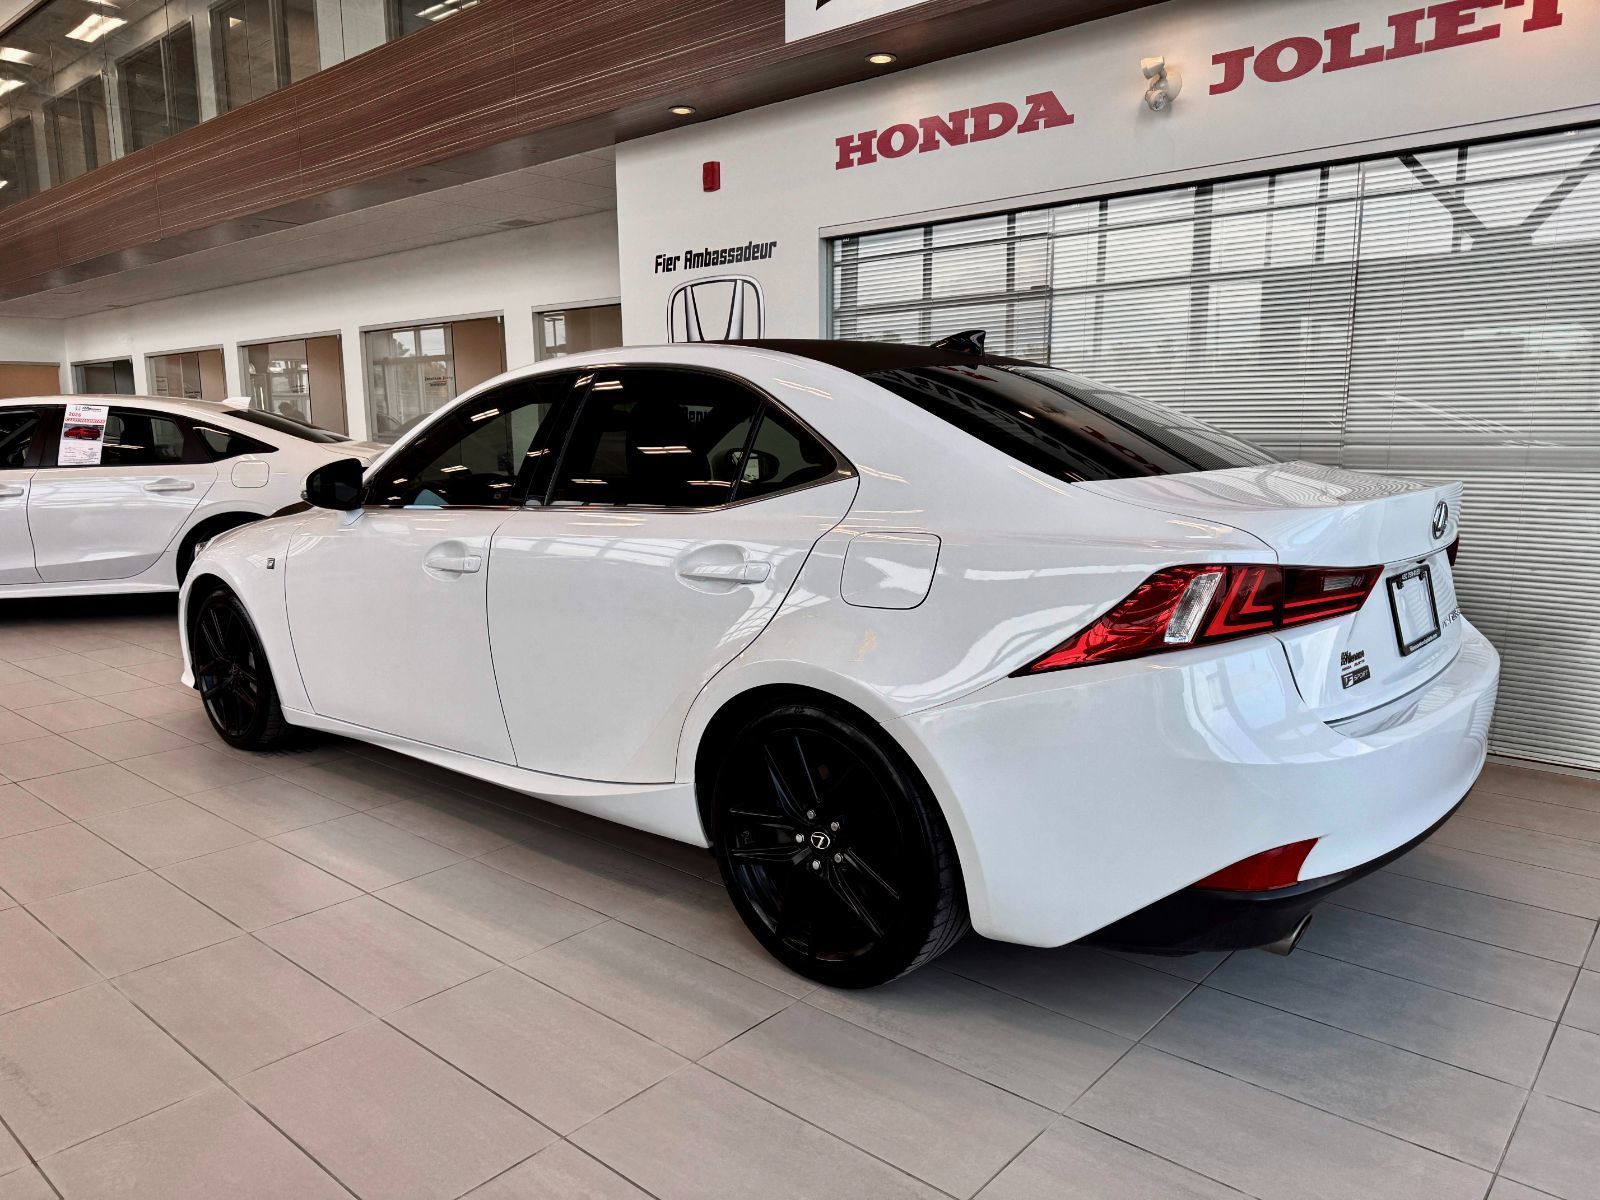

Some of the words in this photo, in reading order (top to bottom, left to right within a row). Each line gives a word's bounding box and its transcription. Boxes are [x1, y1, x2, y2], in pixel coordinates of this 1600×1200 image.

[836, 91, 1075, 170] HONDA
[655, 254, 680, 273] Fier
[684, 241, 777, 270] Ambassadeur
